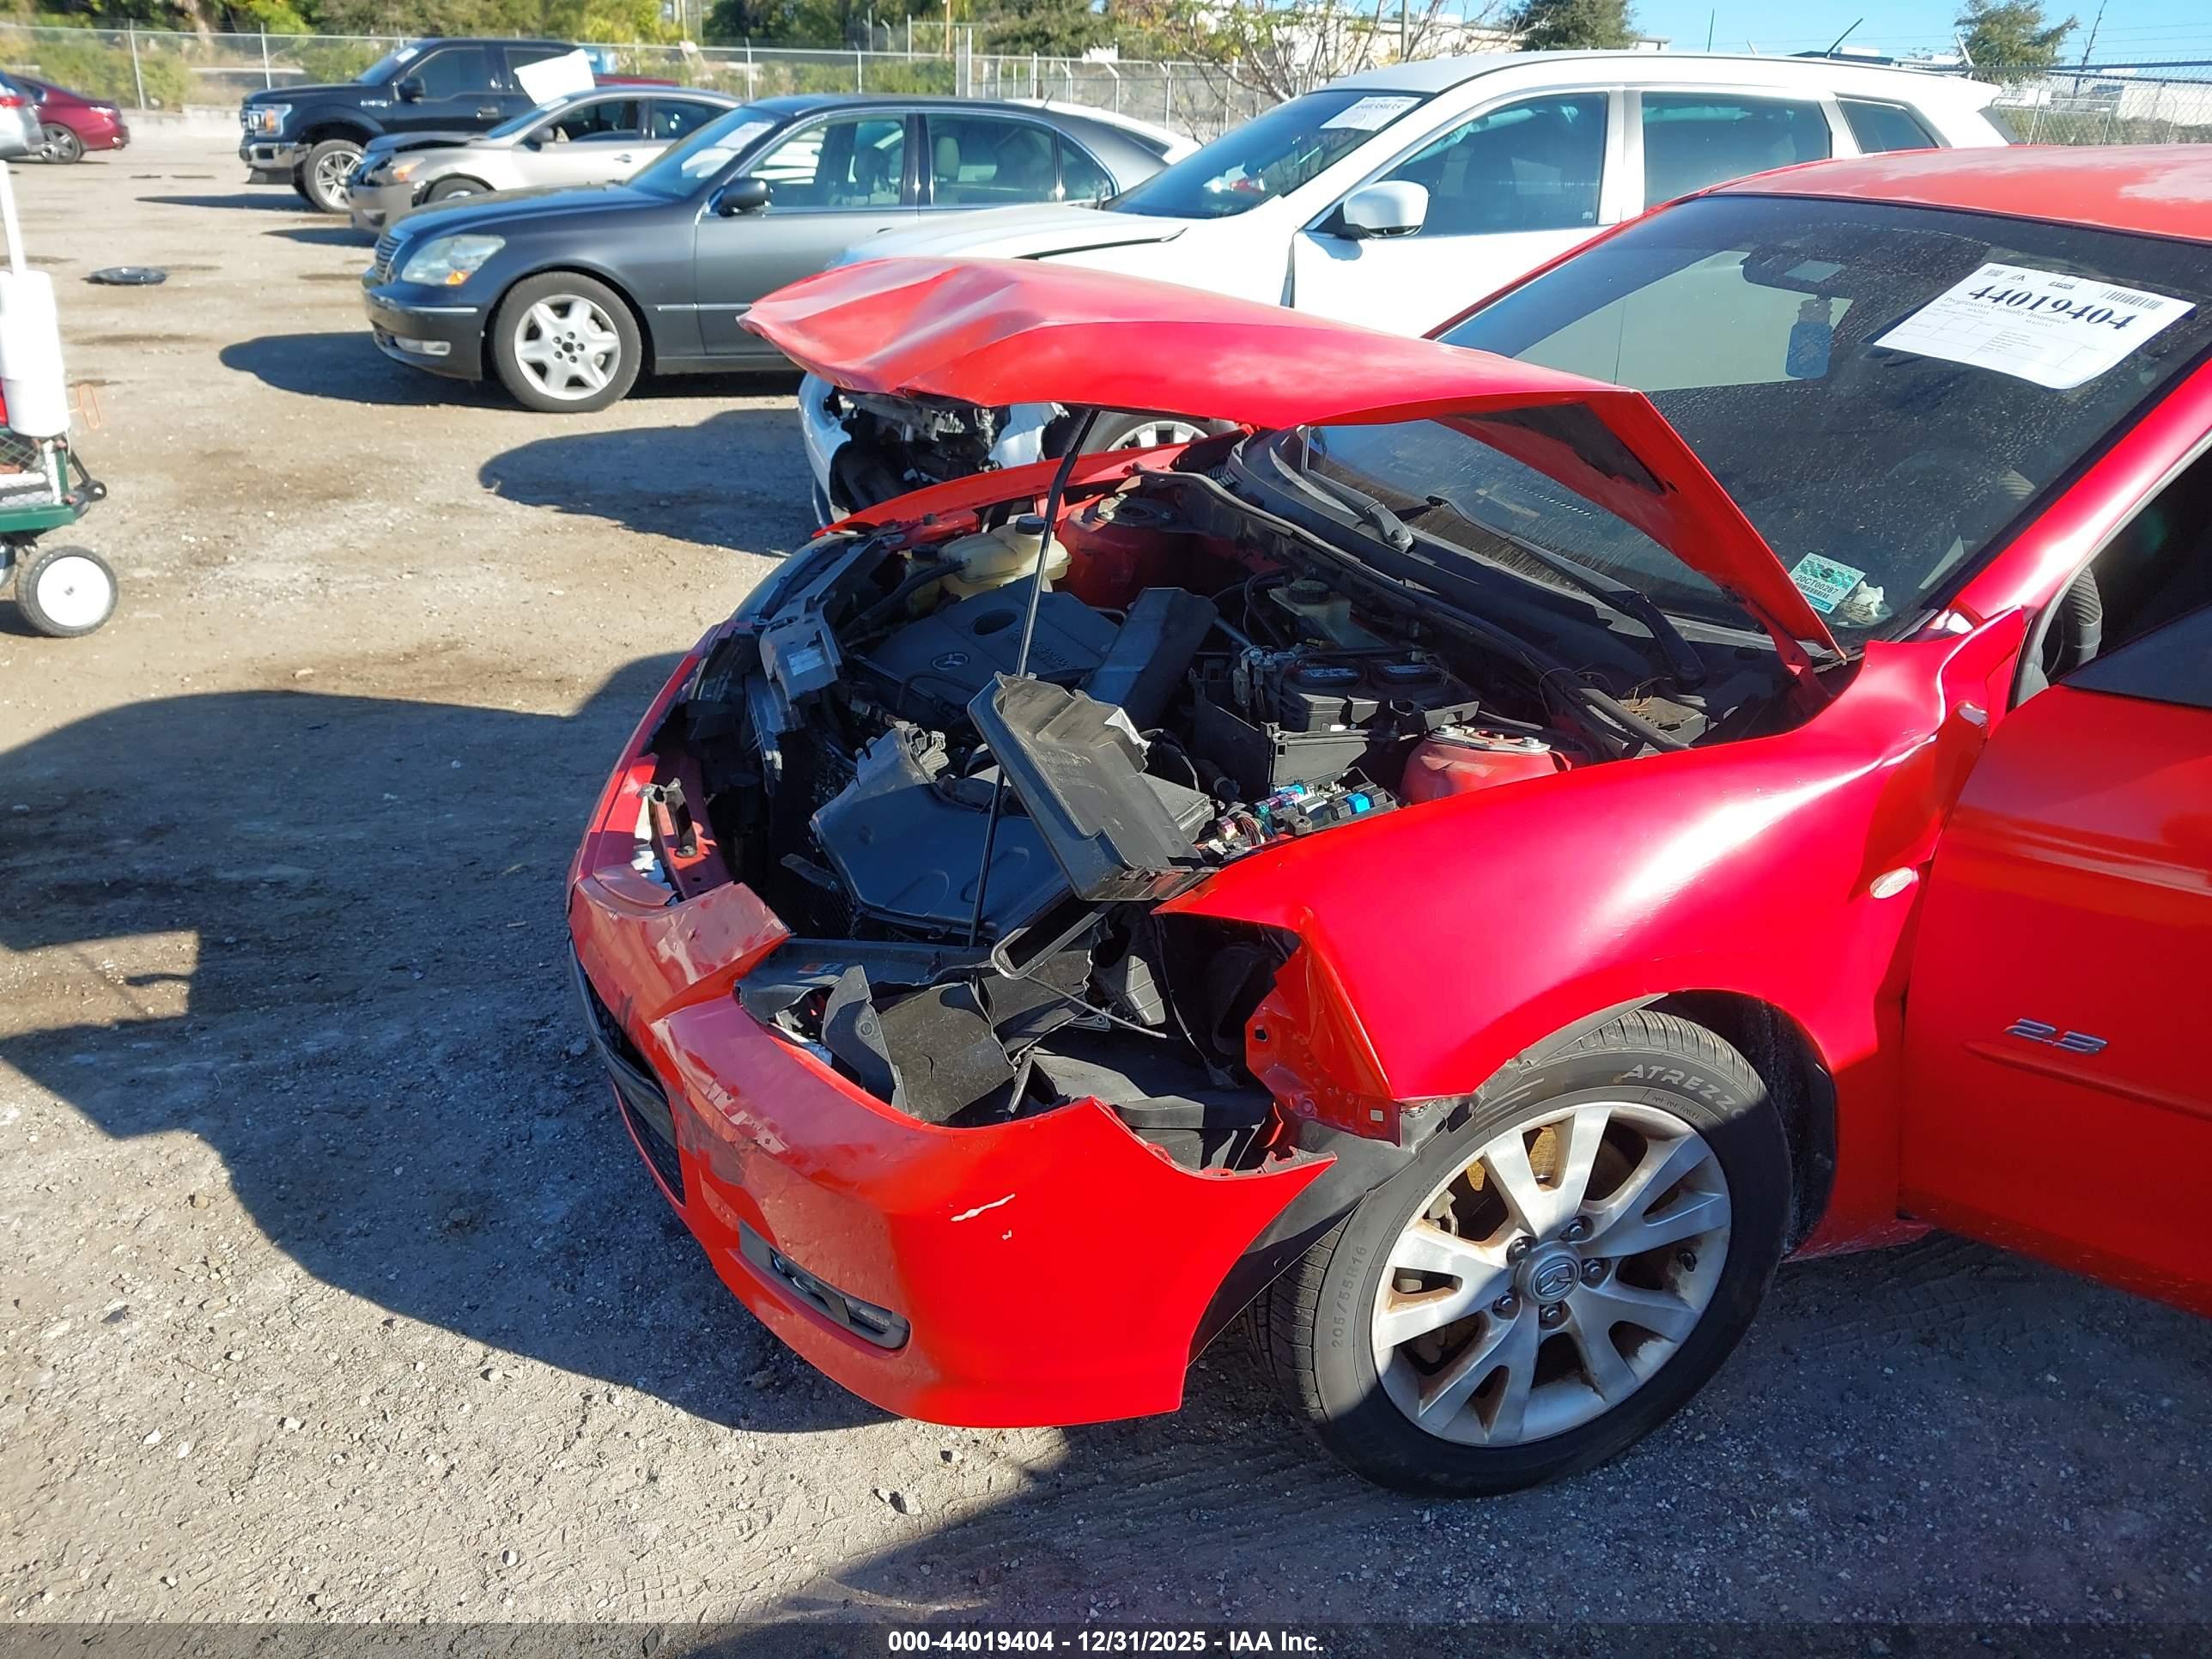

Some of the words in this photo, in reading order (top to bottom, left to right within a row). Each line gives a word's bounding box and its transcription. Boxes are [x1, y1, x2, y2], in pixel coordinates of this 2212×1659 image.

[1943, 296, 1990, 309] Progressive
[2027, 312, 2069, 325] Insurance
[1967, 284, 2139, 330] 44019404
[1332, 1244, 1367, 1348] 205/55R16
